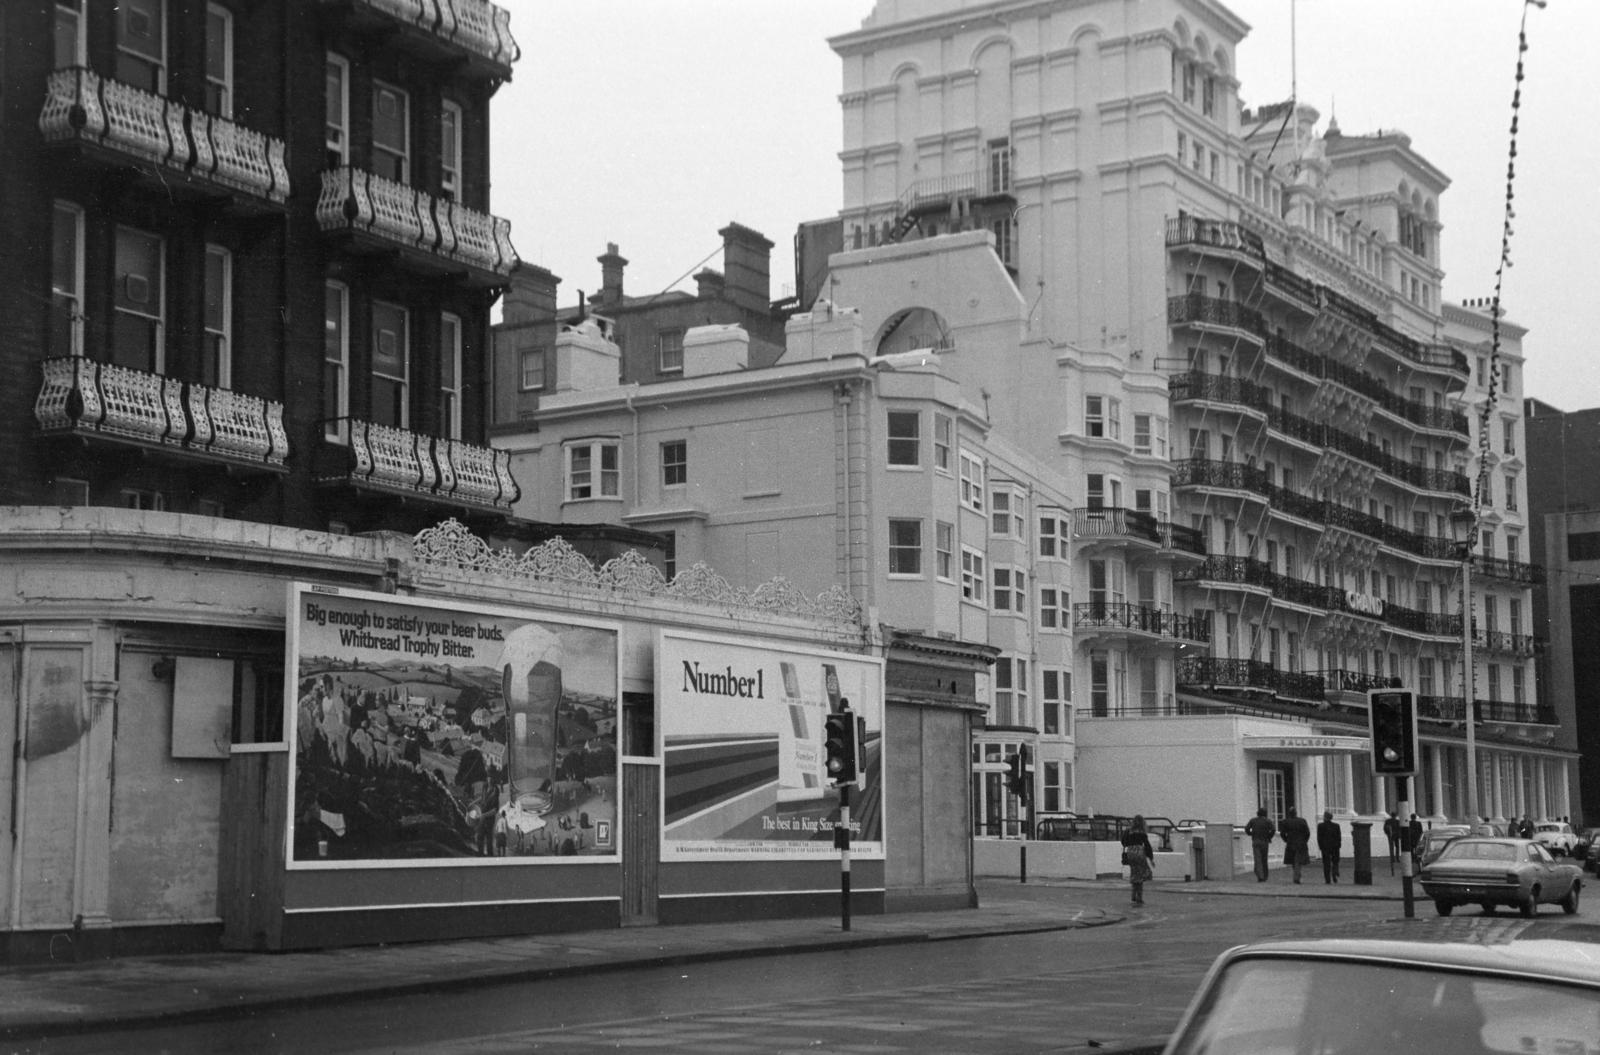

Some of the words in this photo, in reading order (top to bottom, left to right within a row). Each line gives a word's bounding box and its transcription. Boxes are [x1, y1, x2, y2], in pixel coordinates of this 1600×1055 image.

[1345, 590, 1382, 616] GRAND
[306, 603, 326, 626] Big
[328, 609, 371, 630] enough
[373, 612, 384, 629] to
[386, 614, 423, 636] satisfy
[425, 621, 450, 637] your
[452, 620, 476, 639] beer
[477, 623, 505, 641] buds.
[339, 628, 400, 652] Whitbread
[402, 635, 440, 658] Trophy
[442, 639, 475, 659] Bitter.
[762, 815, 776, 830] The
[776, 816, 791, 831] best
[792, 817, 800, 830] in
[802, 816, 818, 833] King
[820, 817, 833, 831] Size
[834, 818, 861, 834] sming
